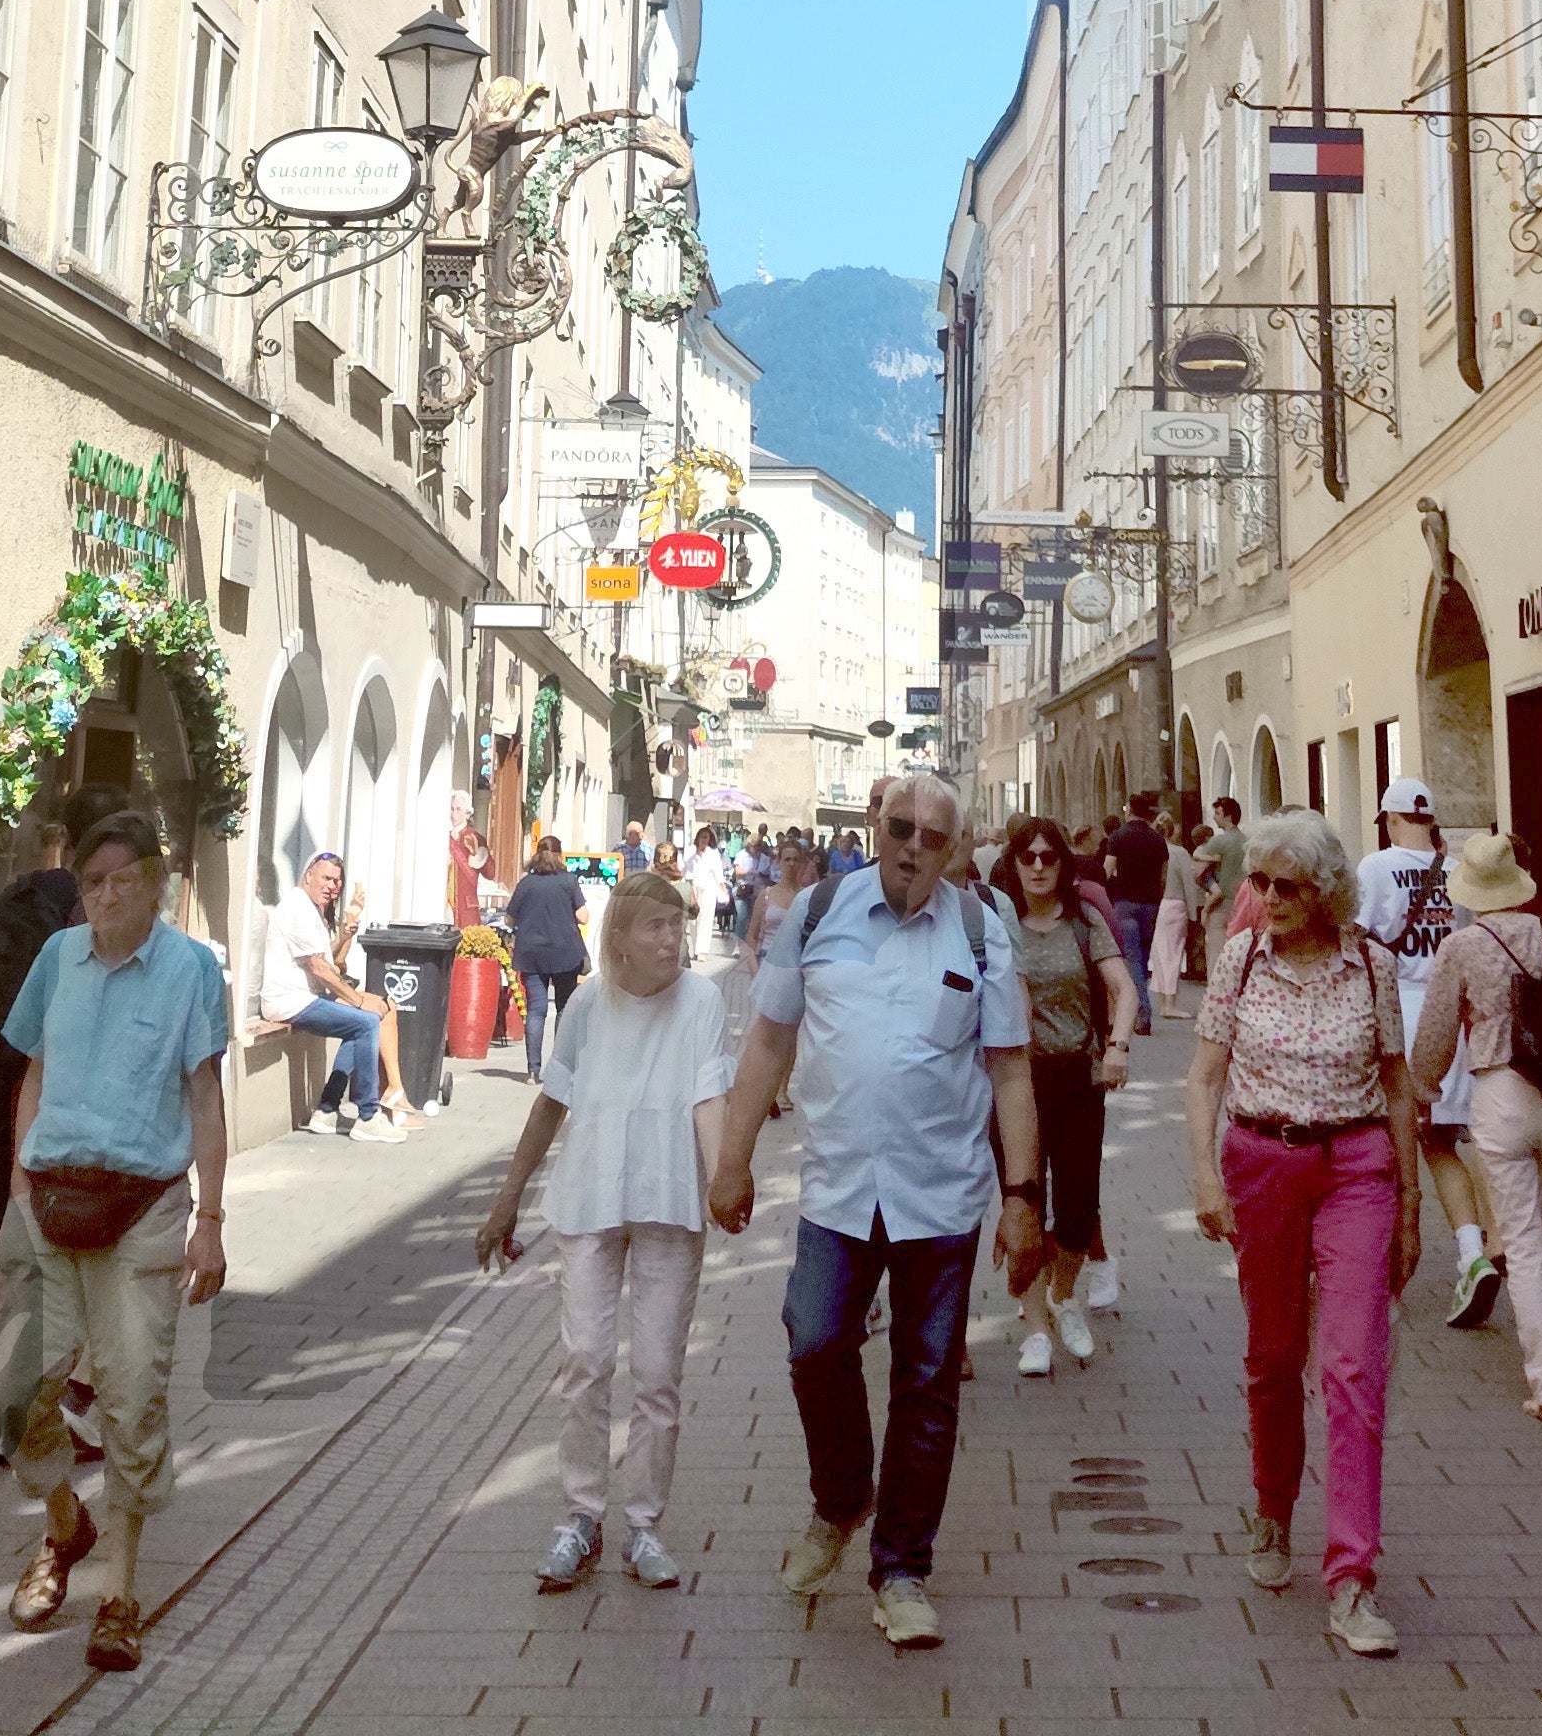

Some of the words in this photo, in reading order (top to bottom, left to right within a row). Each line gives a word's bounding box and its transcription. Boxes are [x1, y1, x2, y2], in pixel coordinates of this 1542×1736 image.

[269, 165, 347, 178] susanne
[550, 447, 633, 464] PANDORA
[680, 550, 716, 567] YUEN
[590, 577, 632, 590] siona
